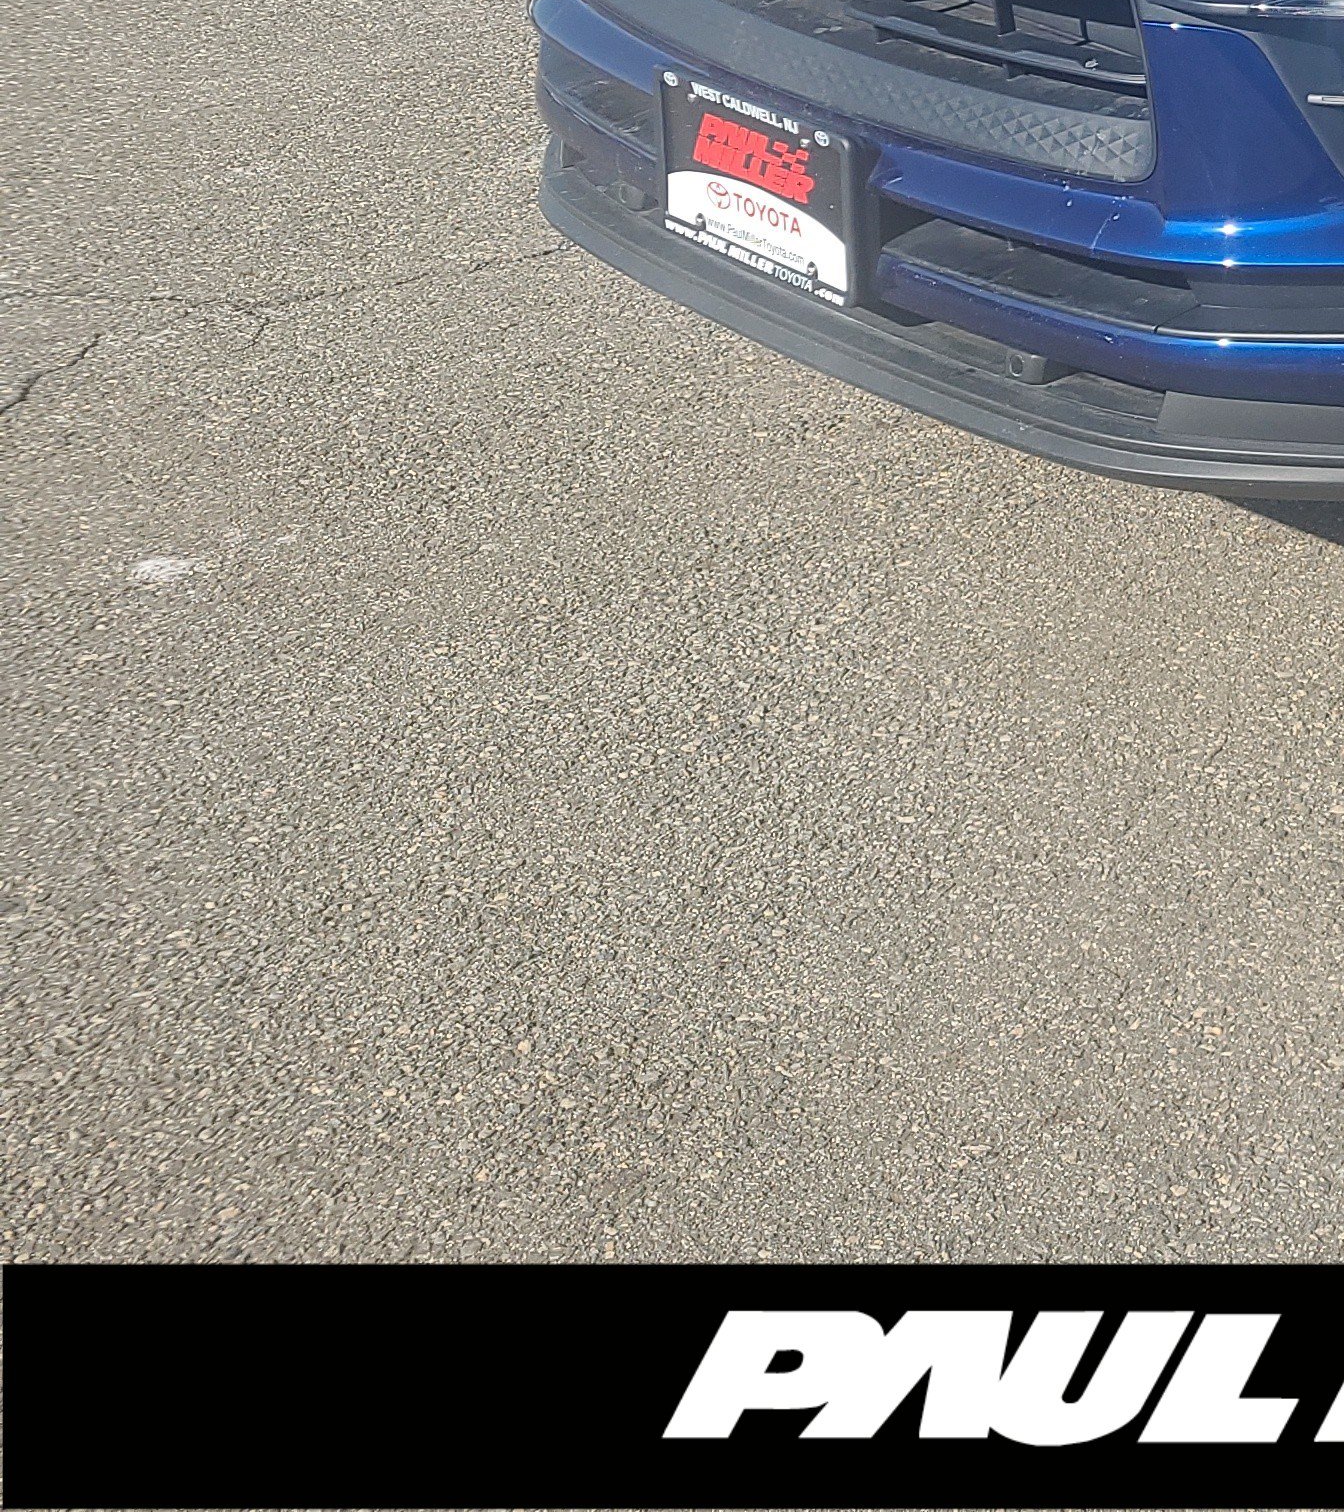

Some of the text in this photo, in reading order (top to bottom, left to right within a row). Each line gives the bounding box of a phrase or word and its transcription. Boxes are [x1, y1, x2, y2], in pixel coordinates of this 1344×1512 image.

[690, 81, 722, 105] WEST
[782, 117, 800, 135] NJ
[700, 112, 783, 168] PAUL
[693, 141, 815, 205] MILLER
[733, 192, 802, 238] TOYOTA
